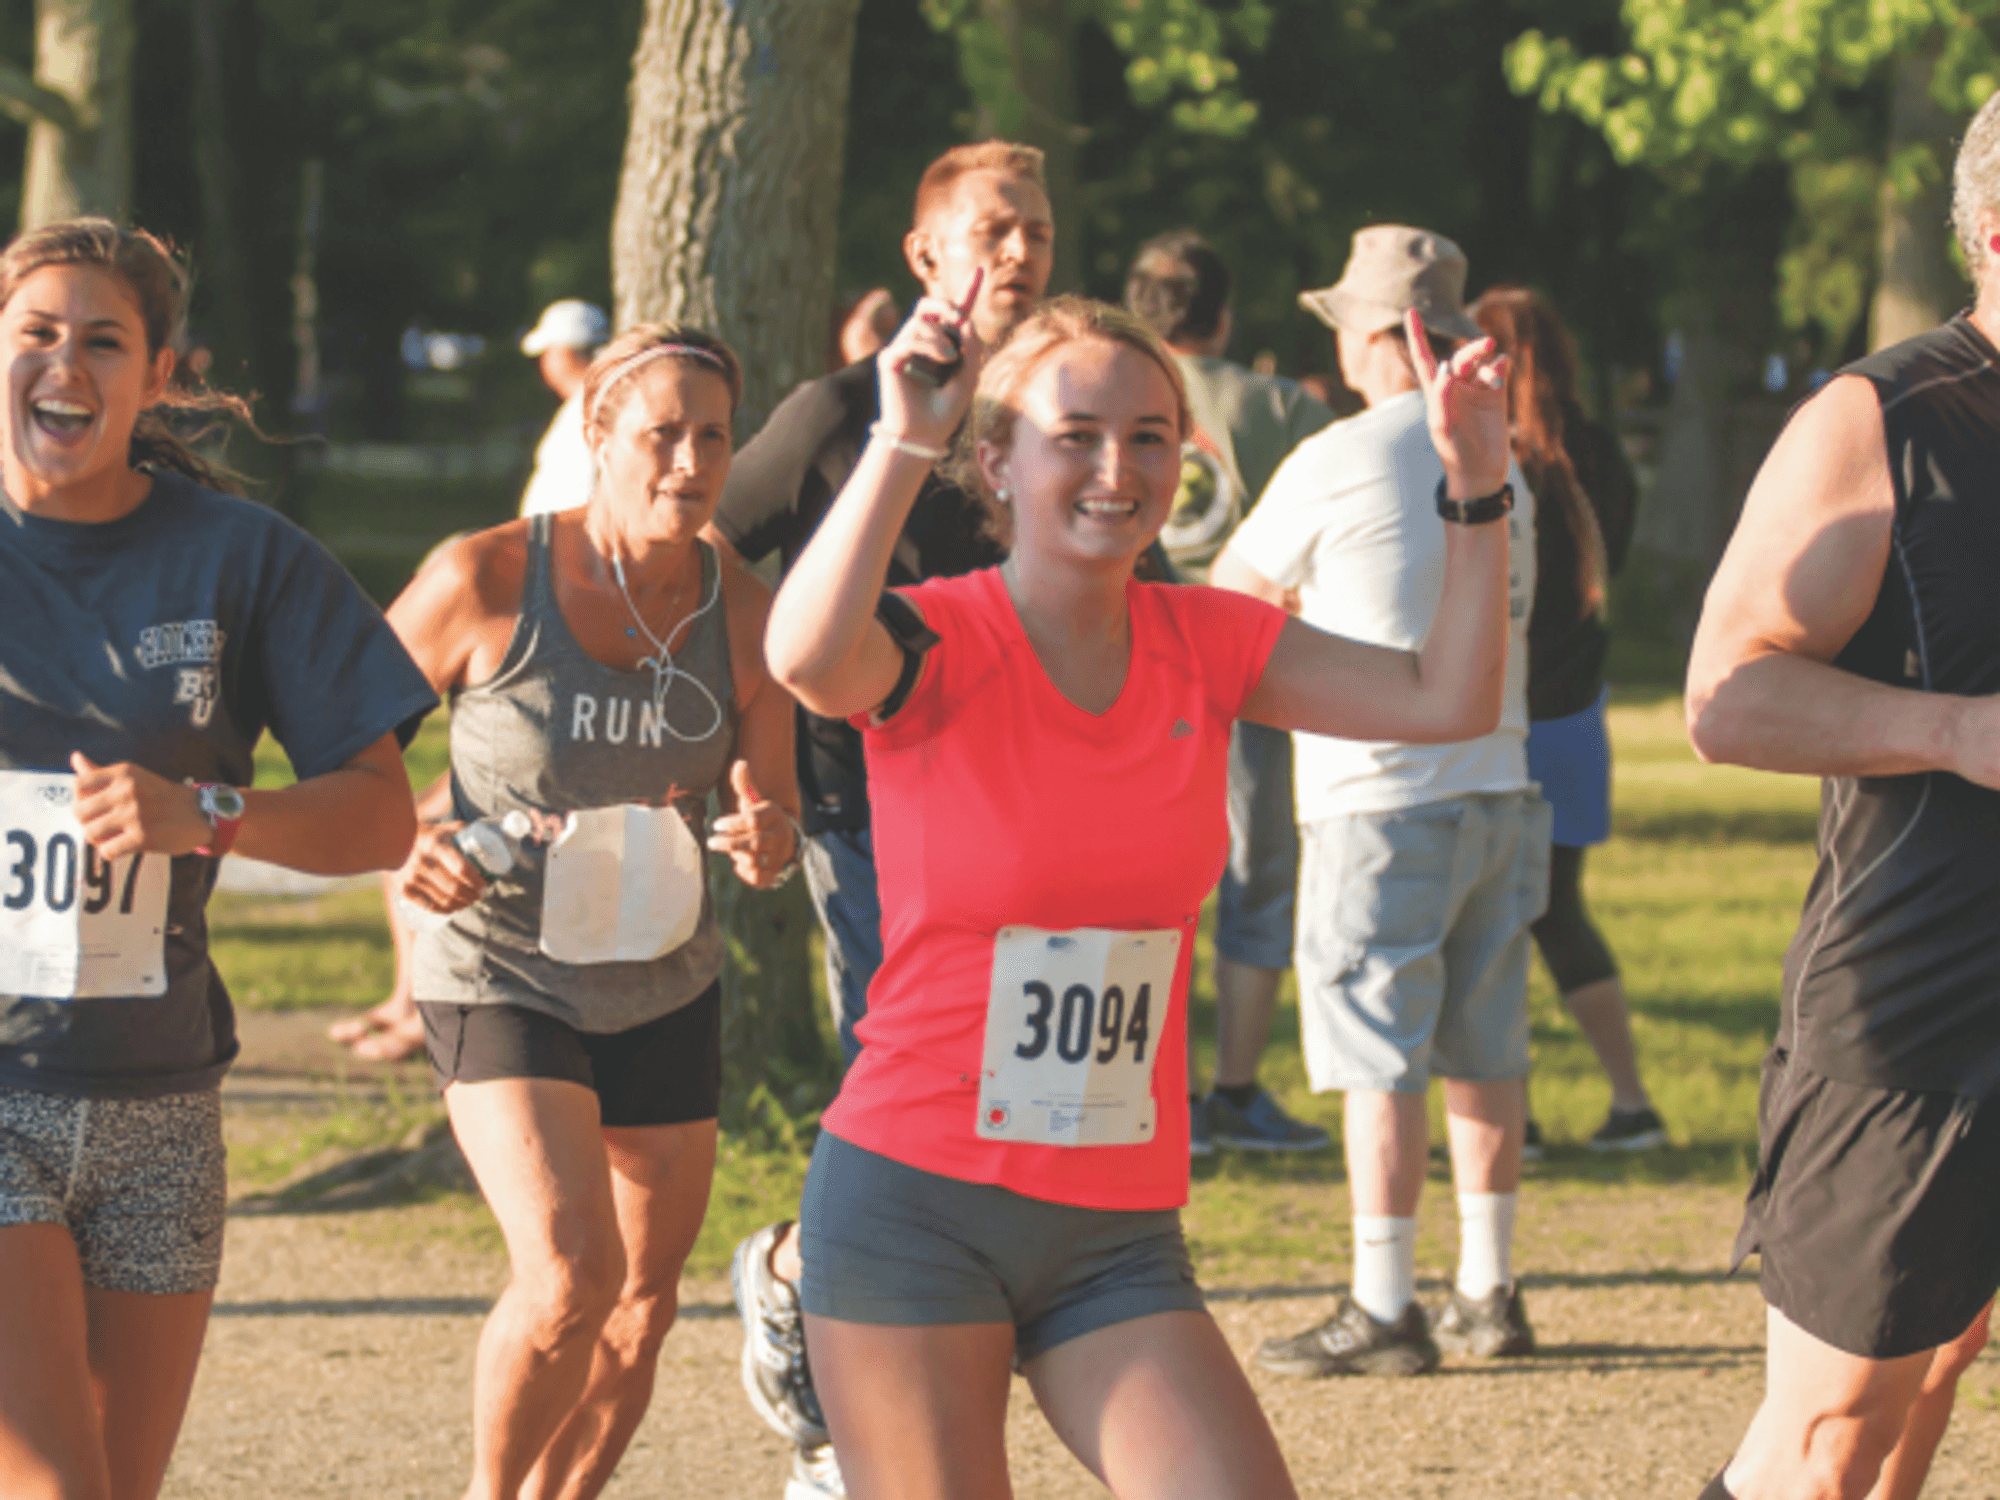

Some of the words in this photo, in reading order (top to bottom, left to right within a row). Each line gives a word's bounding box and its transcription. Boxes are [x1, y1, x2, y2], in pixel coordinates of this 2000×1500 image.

[571, 692, 665, 748] RUN
[3, 828, 143, 915] 3097
[1014, 979, 1152, 1065] 3094
